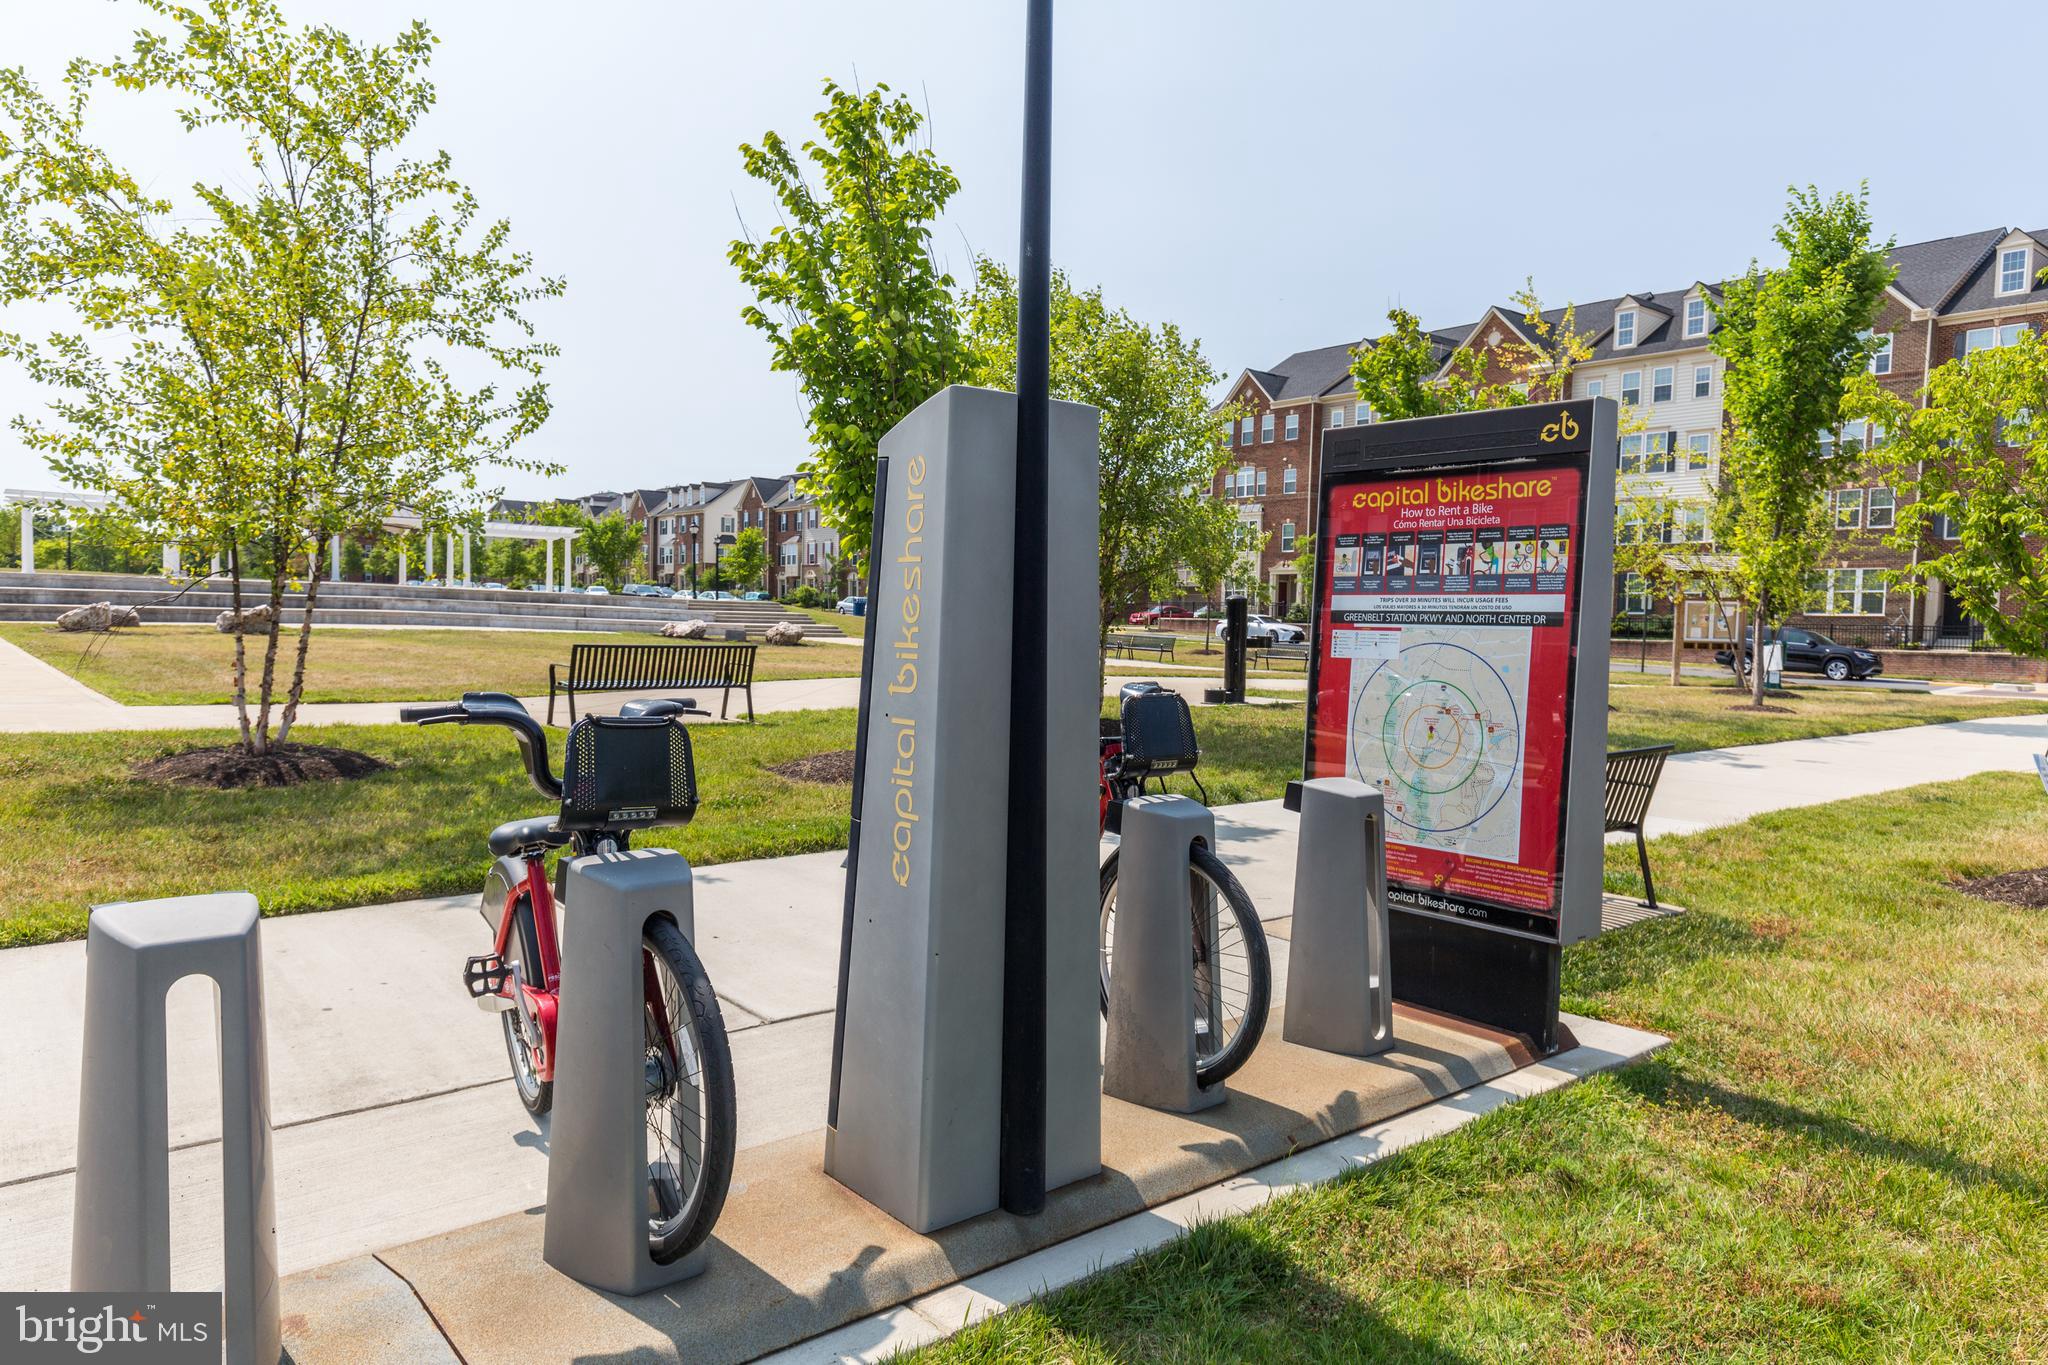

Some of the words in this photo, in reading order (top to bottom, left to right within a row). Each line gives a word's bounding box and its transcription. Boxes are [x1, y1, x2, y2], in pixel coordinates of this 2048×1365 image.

[1352, 482, 1429, 513] capital
[1437, 476, 1552, 503] bikeshare
[1401, 507, 1424, 518] How
[1425, 507, 1436, 517] to
[1438, 504, 1461, 516] Rent
[1463, 507, 1470, 515] a
[1472, 503, 1494, 514] Bike
[1393, 518, 1418, 529] Cómo
[1419, 516, 1445, 528] Rentar
[1447, 517, 1464, 527] Una
[1466, 515, 1501, 525] Bicicleta
[887, 454, 927, 696] bikeshare
[1343, 613, 1385, 622] GREENBELT
[1386, 613, 1418, 622] STATION
[1418, 613, 1443, 623] PKWY
[1444, 614, 1465, 623] AND
[1466, 614, 1496, 624] NORTH
[1498, 614, 1532, 624] CENTER
[1533, 615, 1547, 624] DR
[889, 717, 920, 888] capital
[1387, 891, 1415, 904] apital
